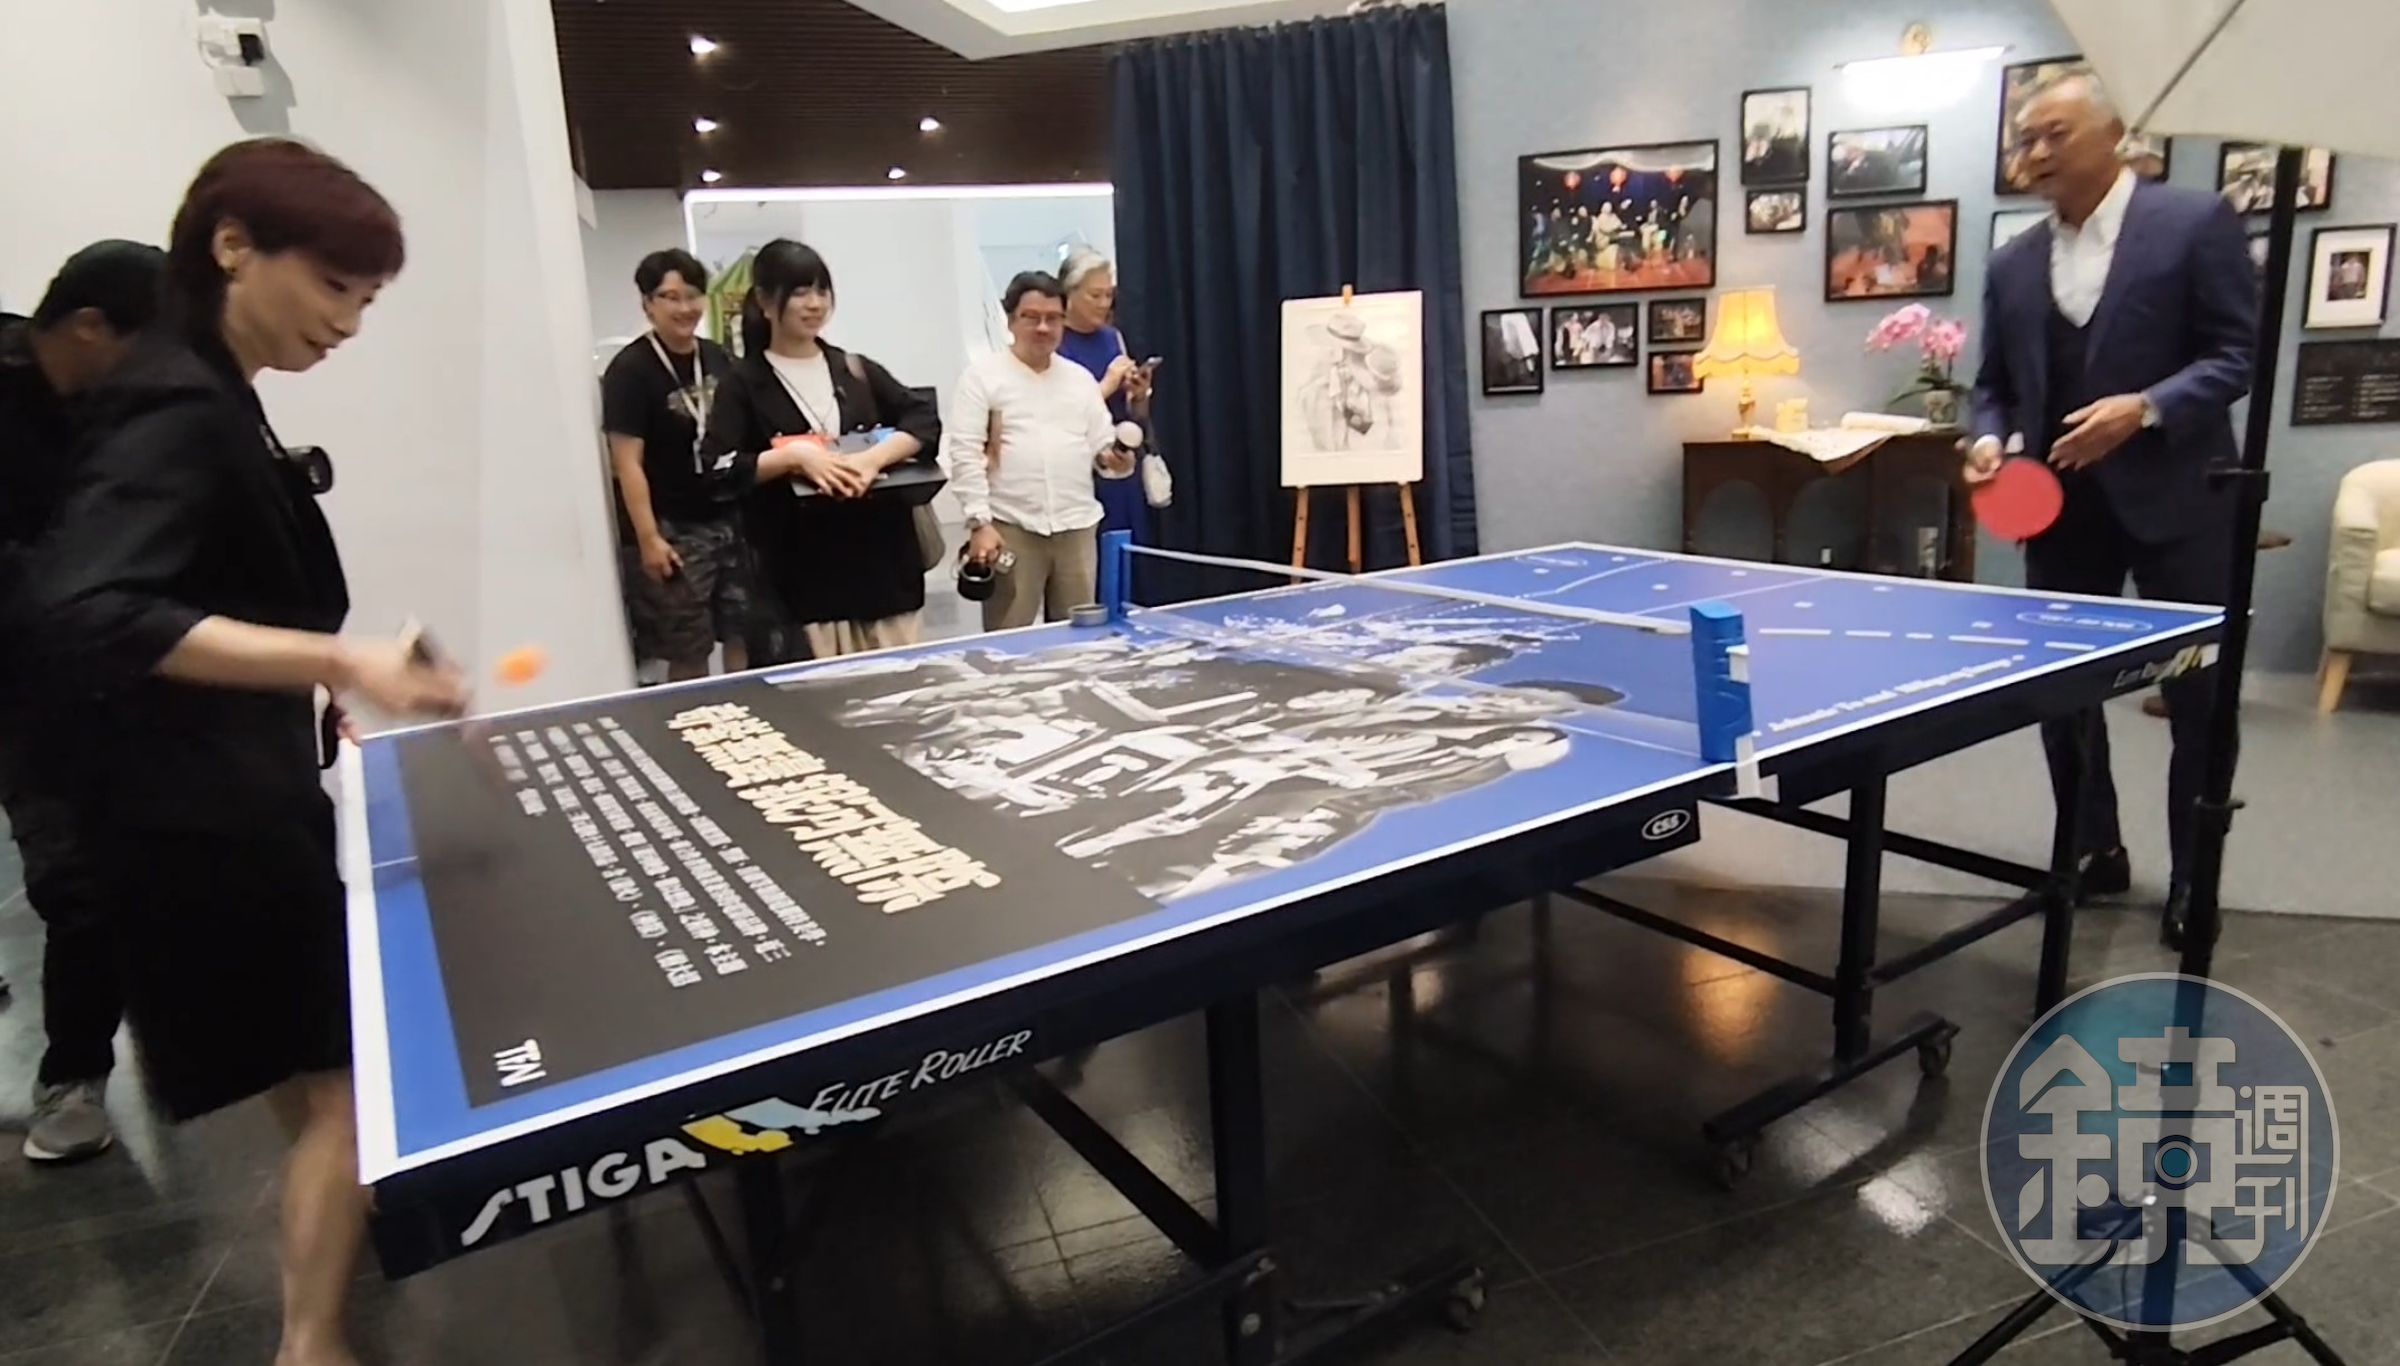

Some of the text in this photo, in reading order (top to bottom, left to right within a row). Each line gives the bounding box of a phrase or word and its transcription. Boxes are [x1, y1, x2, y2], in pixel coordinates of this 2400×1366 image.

[736, 772, 1003, 915] 銀河無際
[910, 1029, 1033, 1090] ROLLER
[460, 1137, 707, 1247] STIGA
